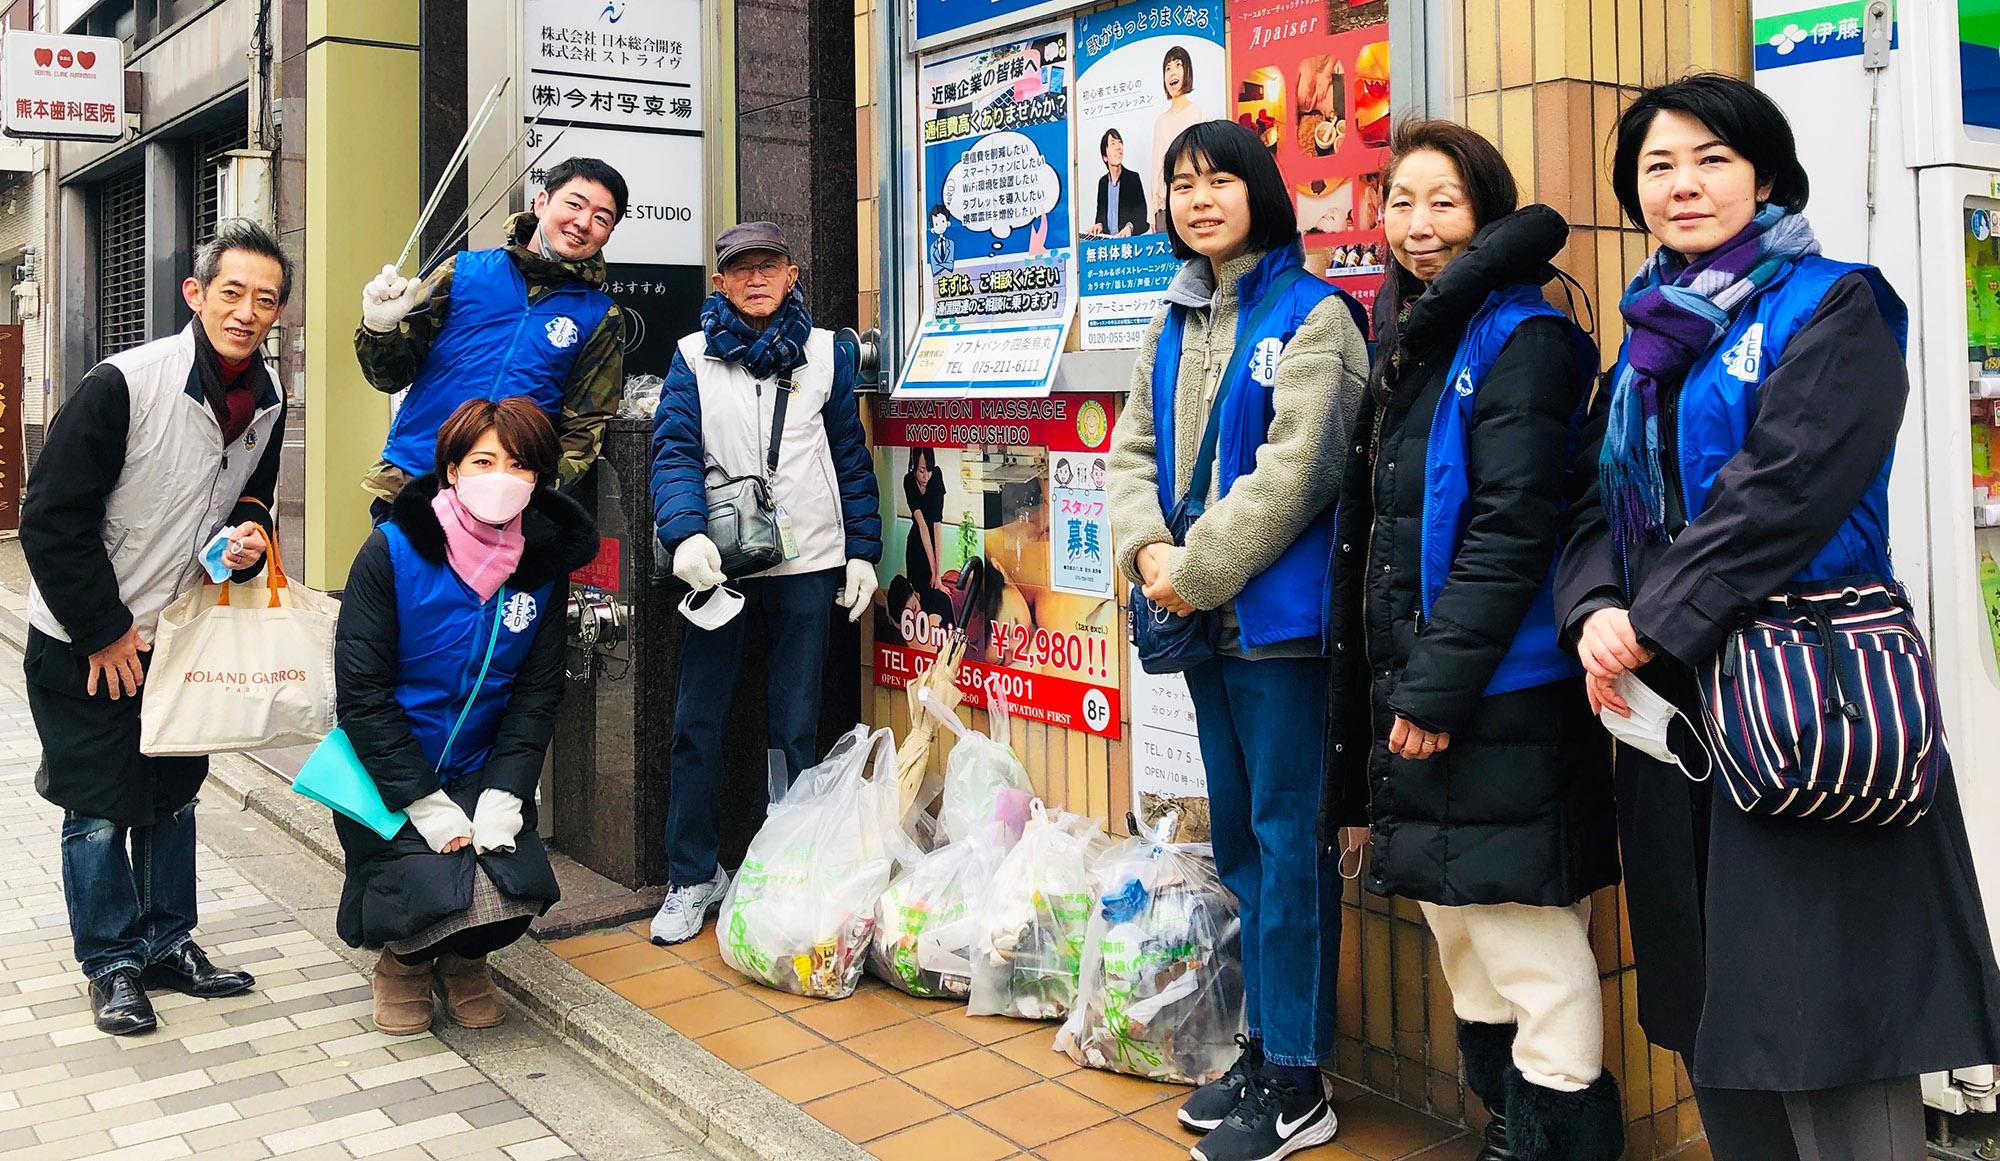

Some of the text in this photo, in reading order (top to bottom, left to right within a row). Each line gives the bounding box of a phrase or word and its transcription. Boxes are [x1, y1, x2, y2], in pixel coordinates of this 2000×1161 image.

[541, 25, 683, 56] 株式会社 日本総合開発
[1086, 5, 1209, 56] 歌がもっとうまくなる
[1249, 17, 1318, 50] Apaiser
[541, 42, 682, 70] 株式会社 ストライヴ
[931, 56, 1038, 106] 近隣企業の皆様へ
[15, 98, 116, 124] 熊本歯科医院
[1083, 95, 1154, 116] マンツーマンレッスン
[526, 130, 543, 148] 3F
[963, 157, 1045, 179] スマートフォンにしたい
[963, 190, 1045, 210] タブレットを導入したい
[636, 204, 692, 222] STUDIO
[1265, 341, 1274, 380] LEO
[1745, 329, 1758, 373] LEO
[946, 359, 1040, 374] TEL 075-211-6111
[879, 400, 1067, 420] RELAXATION MASSAGE
[906, 424, 1030, 445] KYOTO HOGUSHIDO
[1061, 499, 1104, 517] スタッフ
[1066, 517, 1101, 565] 募集
[514, 594, 523, 627] LEO
[901, 608, 953, 647] 60mi
[881, 649, 910, 673] TEL
[183, 669, 306, 685] ROLAND GARROS
[881, 673, 900, 686] OPEN
[1047, 709, 1072, 725] FIRST
[1087, 699, 1106, 721] 8F
[1144, 766, 1166, 780] OPEN
